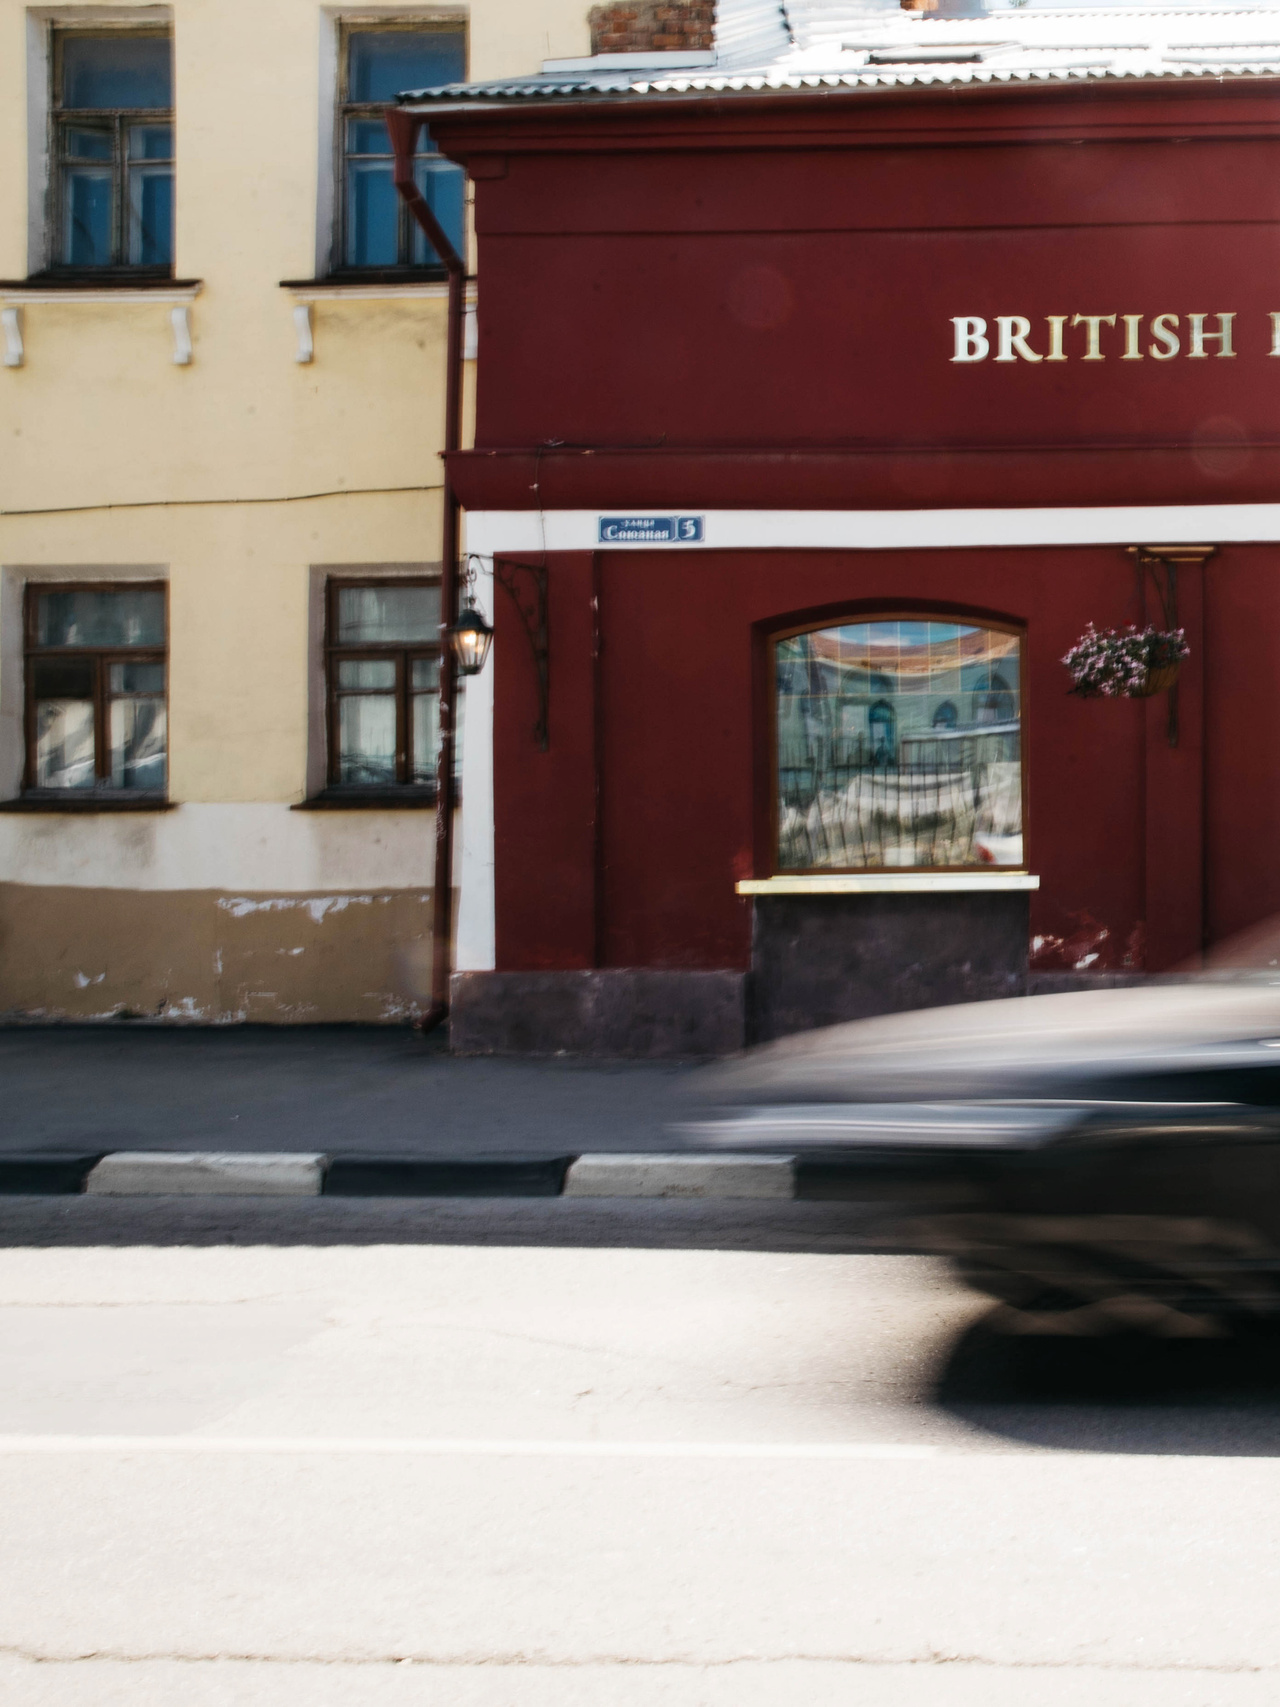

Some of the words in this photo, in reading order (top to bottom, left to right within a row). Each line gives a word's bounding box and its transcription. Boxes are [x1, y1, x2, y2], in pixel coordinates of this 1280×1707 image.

[949, 312, 1238, 363] BRITISH
[603, 525, 669, 540] Союзная
[682, 519, 696, 539] 5
